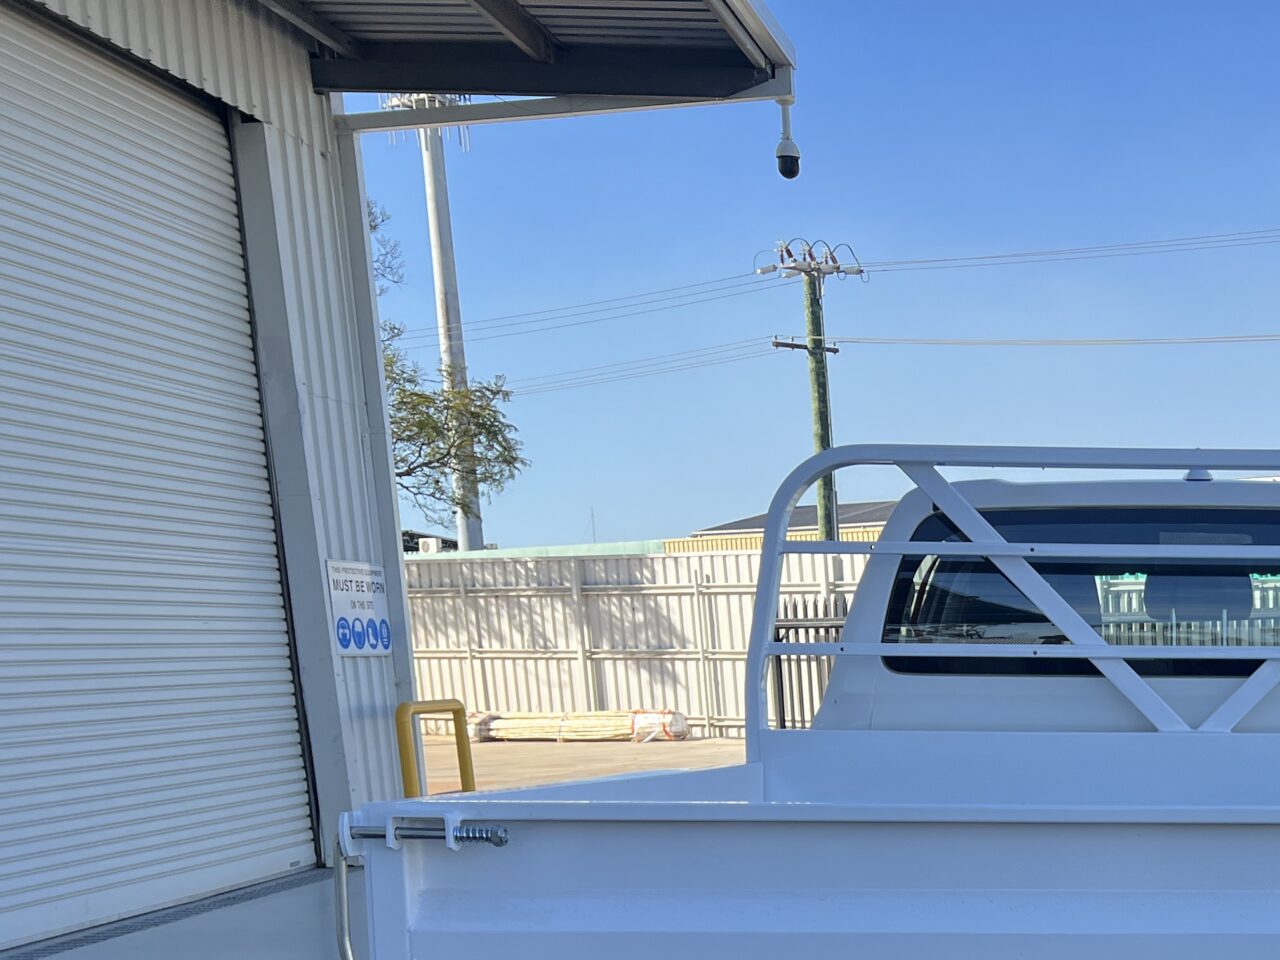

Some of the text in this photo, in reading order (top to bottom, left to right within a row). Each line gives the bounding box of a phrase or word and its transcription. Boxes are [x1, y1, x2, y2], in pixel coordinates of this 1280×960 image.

[331, 566, 341, 574] THIS
[333, 578, 384, 594] MUST BE WORN
[351, 600, 357, 609] ON
[357, 600, 365, 609] THIS
